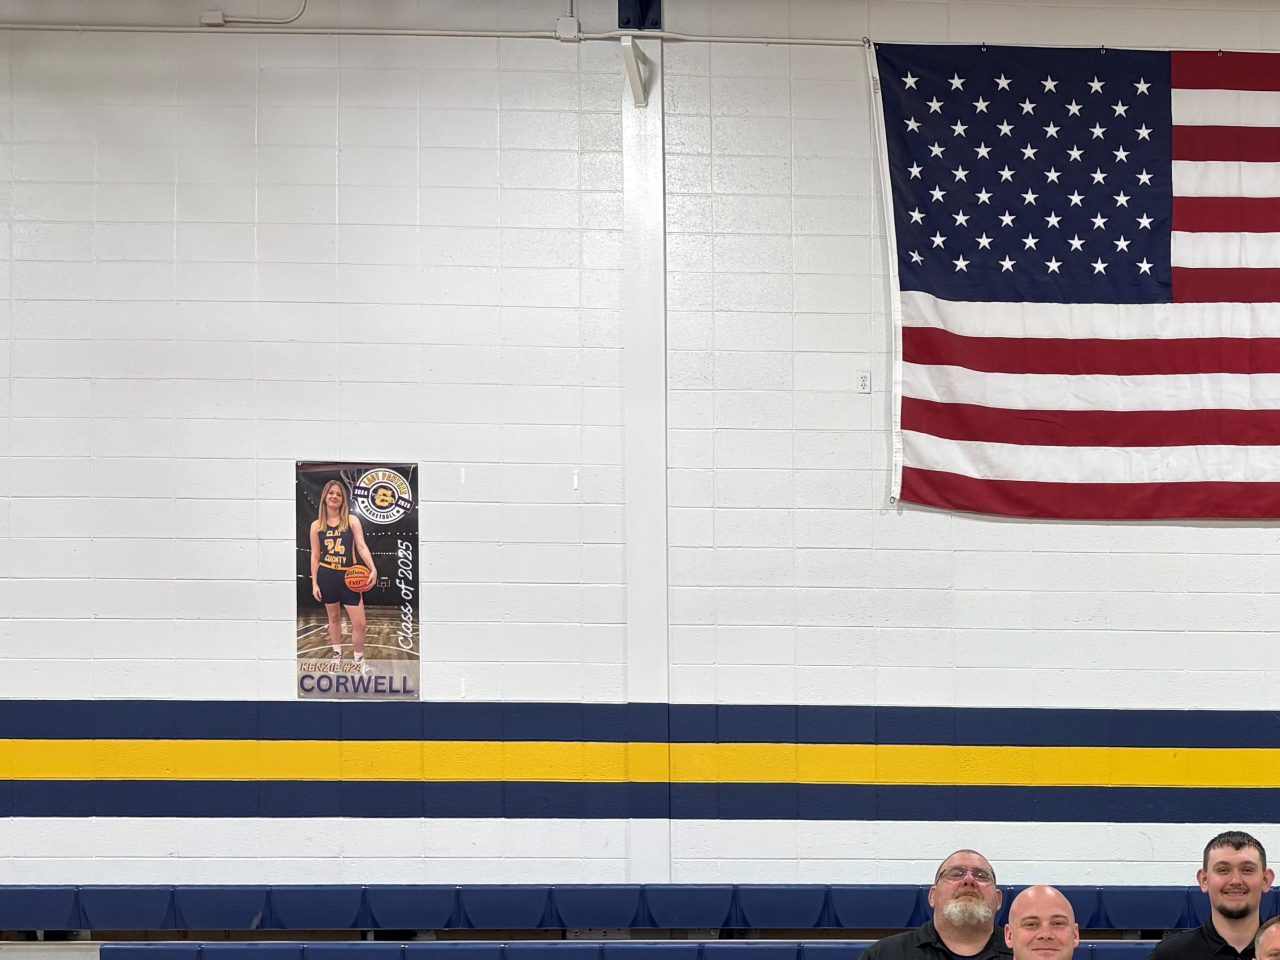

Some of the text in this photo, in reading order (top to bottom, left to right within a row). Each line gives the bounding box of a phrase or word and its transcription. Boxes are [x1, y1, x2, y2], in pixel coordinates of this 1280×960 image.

[324, 537, 346, 555] 24
[324, 554, 347, 565] COUNTY
[396, 540, 415, 649] Class of 2025
[300, 662, 340, 673] KENZIE
[300, 674, 415, 694] CORWELL
